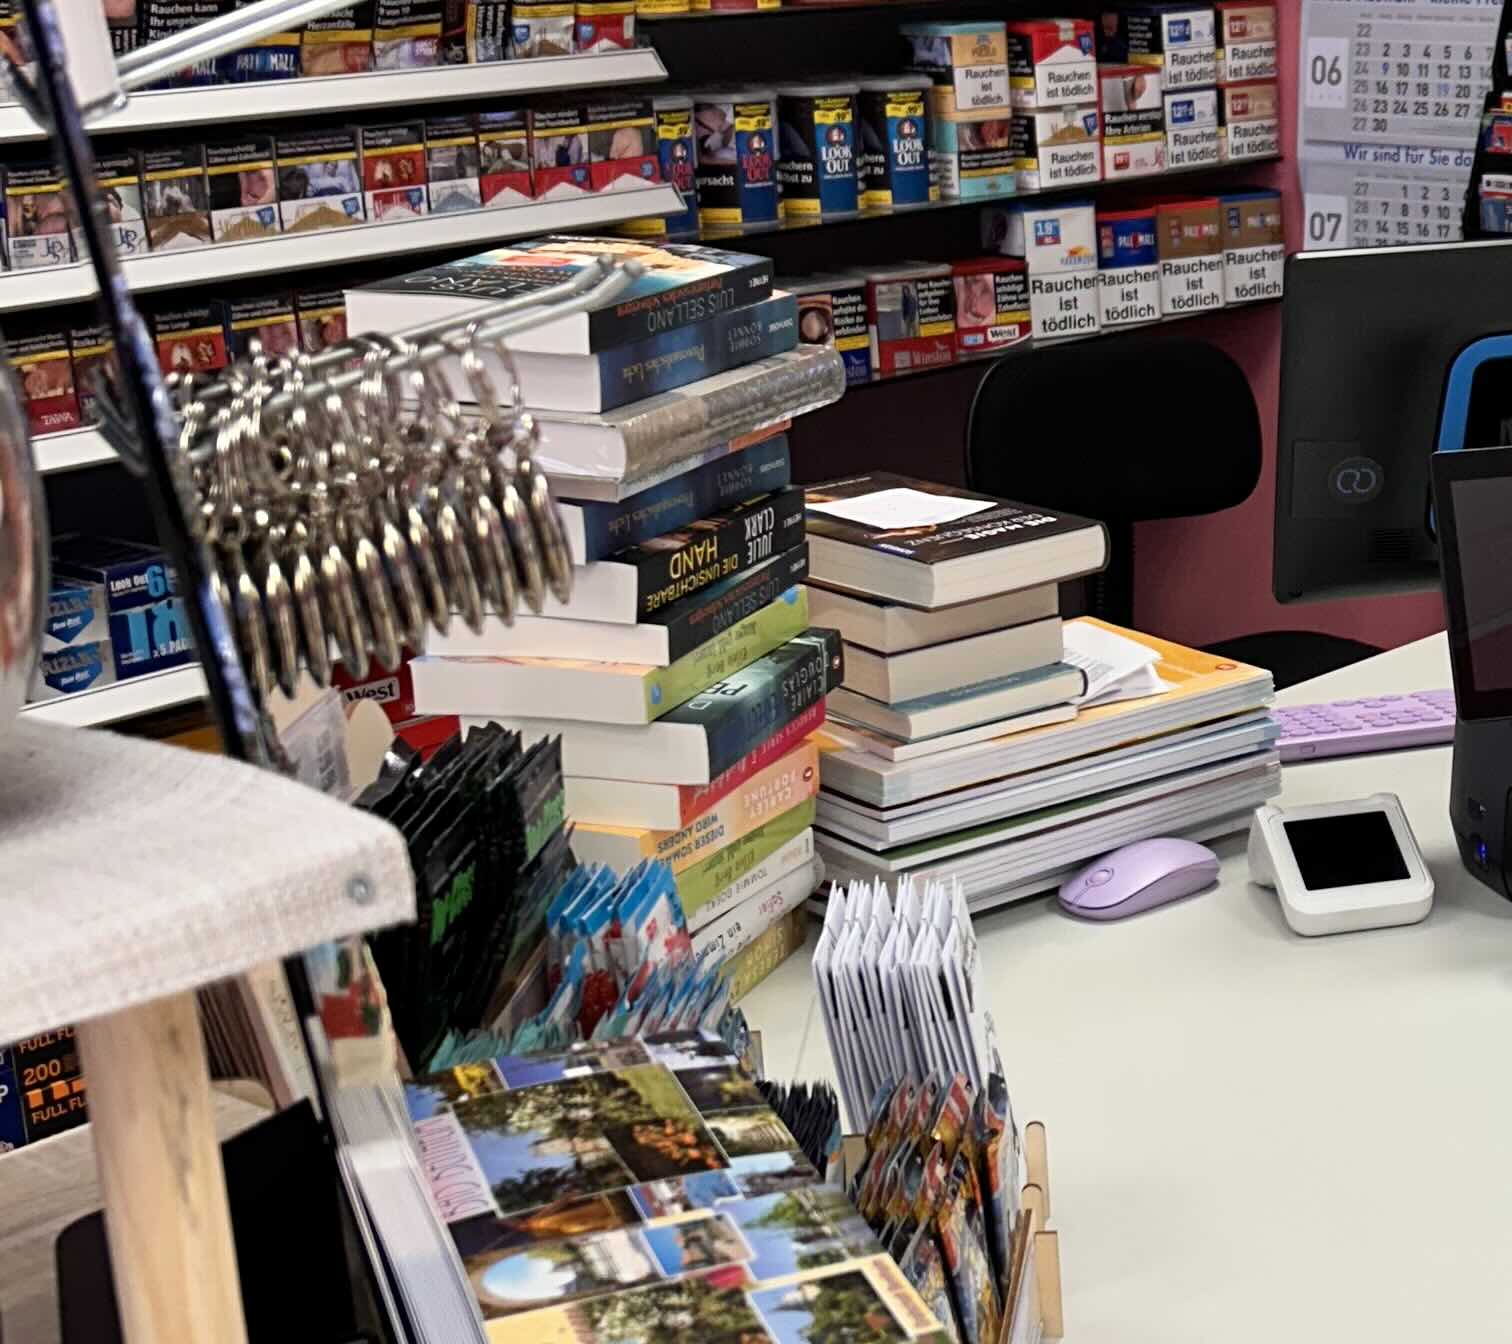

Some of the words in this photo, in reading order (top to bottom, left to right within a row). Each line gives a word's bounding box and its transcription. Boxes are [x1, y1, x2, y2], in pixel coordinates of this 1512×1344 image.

[1047, 71, 1091, 83] Rauchen
[1311, 54, 1342, 86] 06
[1046, 88, 1060, 98] ist
[1062, 84, 1094, 97] tödlich
[1344, 146, 1369, 161] Wir
[1373, 147, 1400, 162] sind
[1406, 148, 1426, 165] für
[1429, 149, 1451, 166] Sie
[1309, 211, 1342, 242] 07
[1162, 259, 1223, 276] Rauchen
[1187, 277, 1203, 289] ist
[1172, 293, 1220, 309] tödlich
[745, 507, 775, 539] CLARK
[669, 535, 718, 578] HAND
[747, 532, 773, 564] JULIE
[24, 1059, 60, 1086] 200
